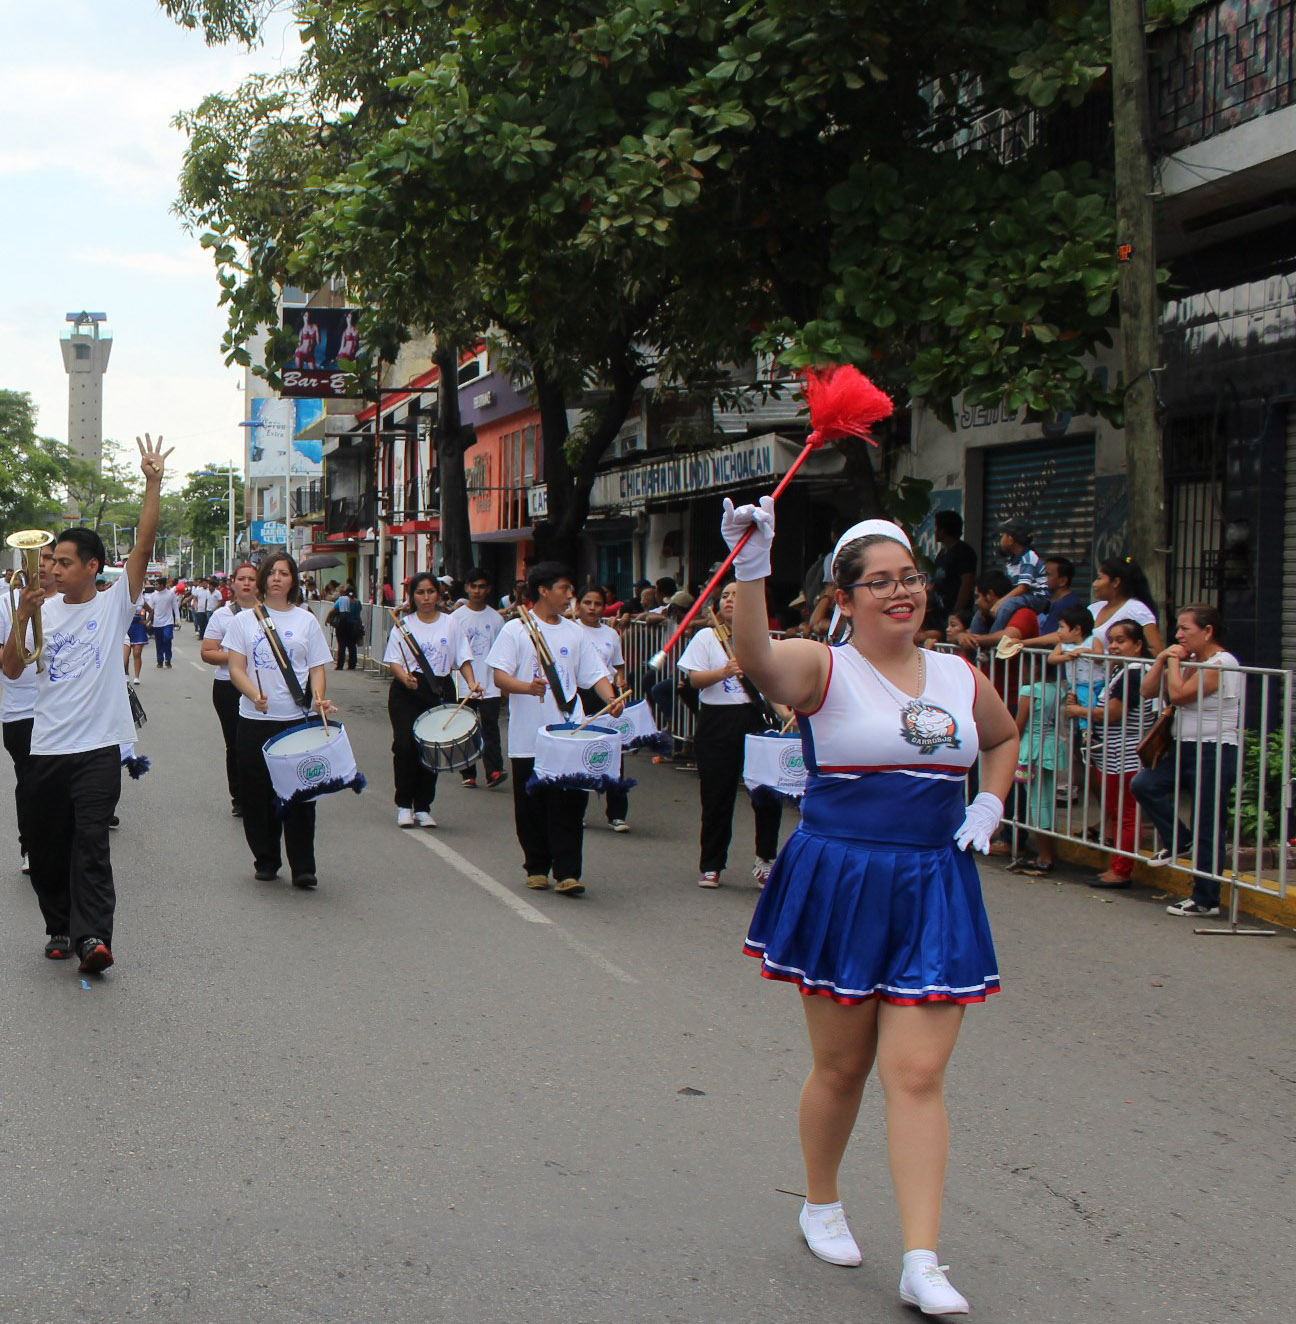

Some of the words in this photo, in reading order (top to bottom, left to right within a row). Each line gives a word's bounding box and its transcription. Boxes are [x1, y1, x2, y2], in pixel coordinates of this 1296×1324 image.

[283, 371, 359, 388] Bar-B
[684, 456, 710, 488] LINDO
[713, 446, 770, 482] MICHOACAN
